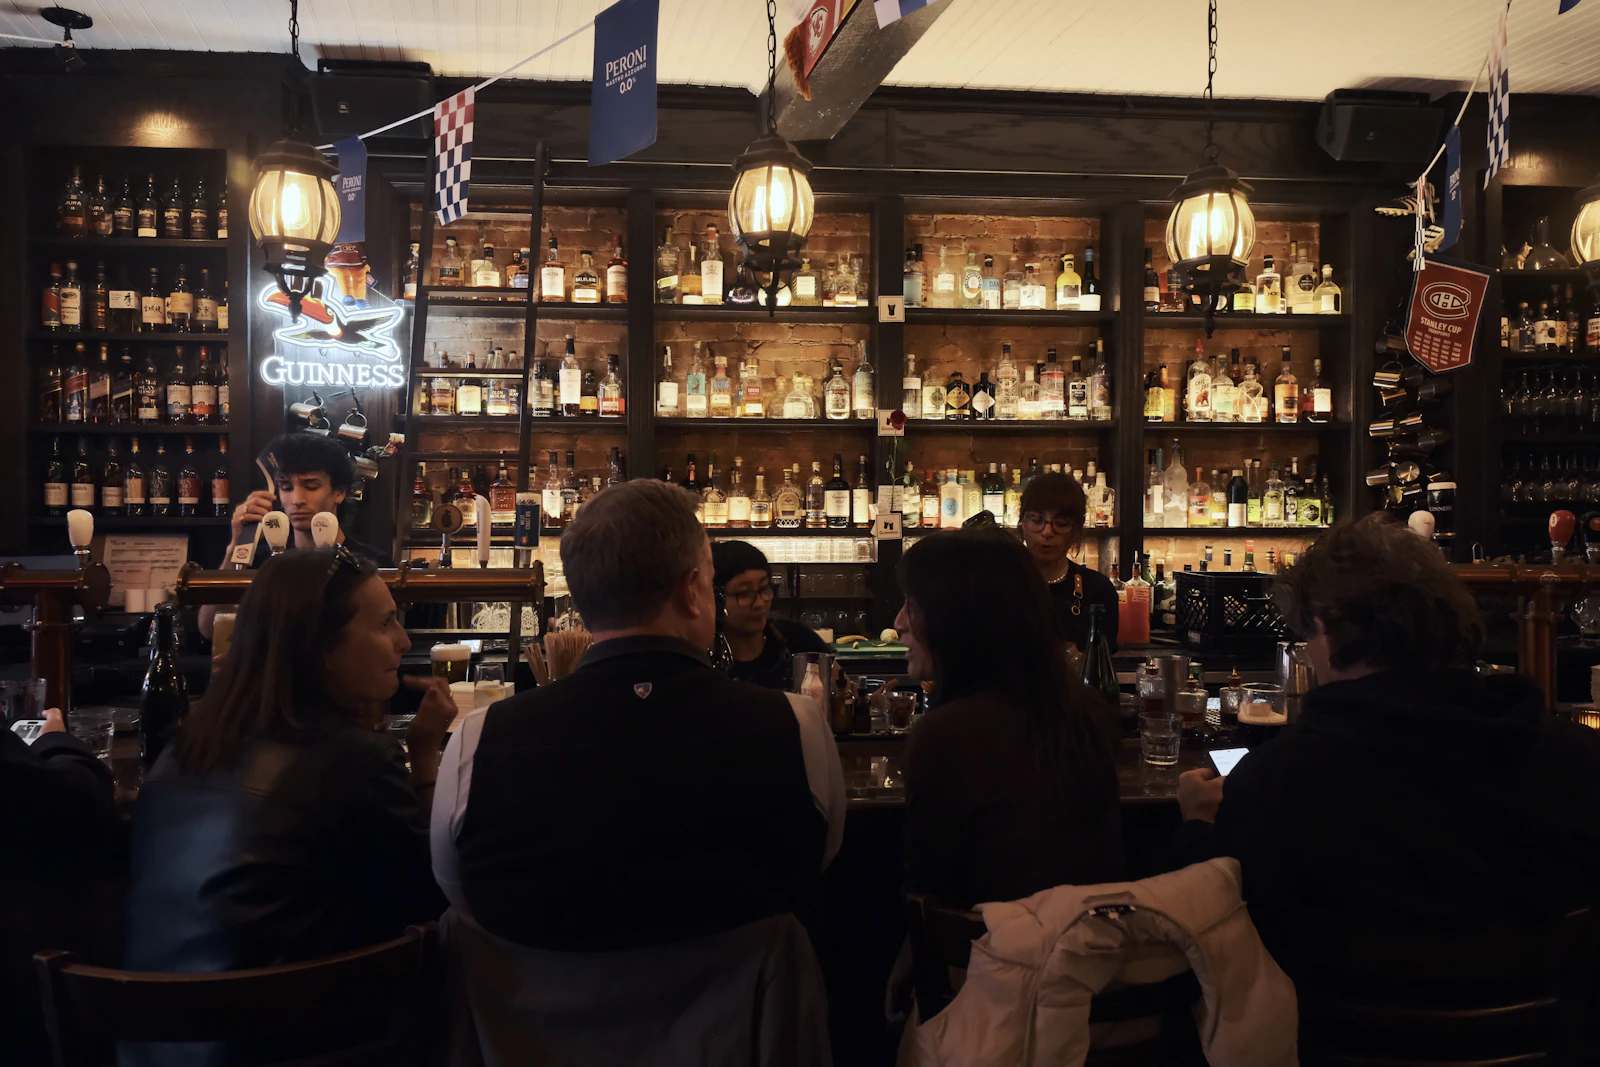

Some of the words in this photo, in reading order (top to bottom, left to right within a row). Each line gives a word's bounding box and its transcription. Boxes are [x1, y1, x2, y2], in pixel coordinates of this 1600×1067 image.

[605, 45, 647, 81] PERONI
[605, 74, 625, 88] NASTRO
[625, 62, 647, 79] AZZURRO
[342, 175, 362, 189] PERONI
[1420, 316, 1448, 331] STANLEY
[1447, 324, 1462, 335] CUP
[260, 356, 405, 389] GUINNESS
